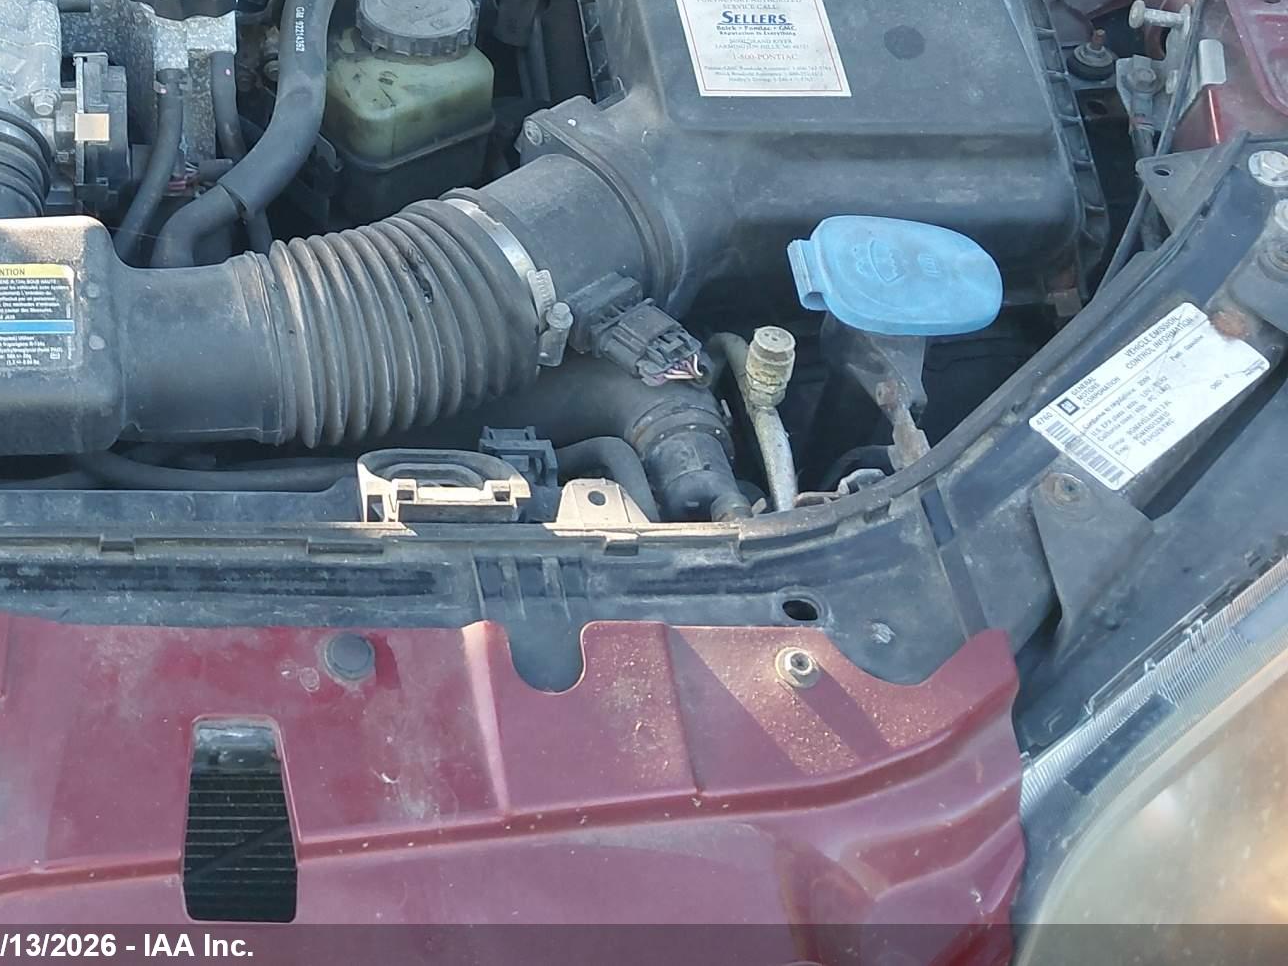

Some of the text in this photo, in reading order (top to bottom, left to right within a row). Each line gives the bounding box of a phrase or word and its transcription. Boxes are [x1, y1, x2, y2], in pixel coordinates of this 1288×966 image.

[721, 10, 787, 24] SELLERS
[1124, 315, 1181, 357] VEHICLE EMISSION
[1126, 317, 1194, 370] CONTROL INFORMATION
